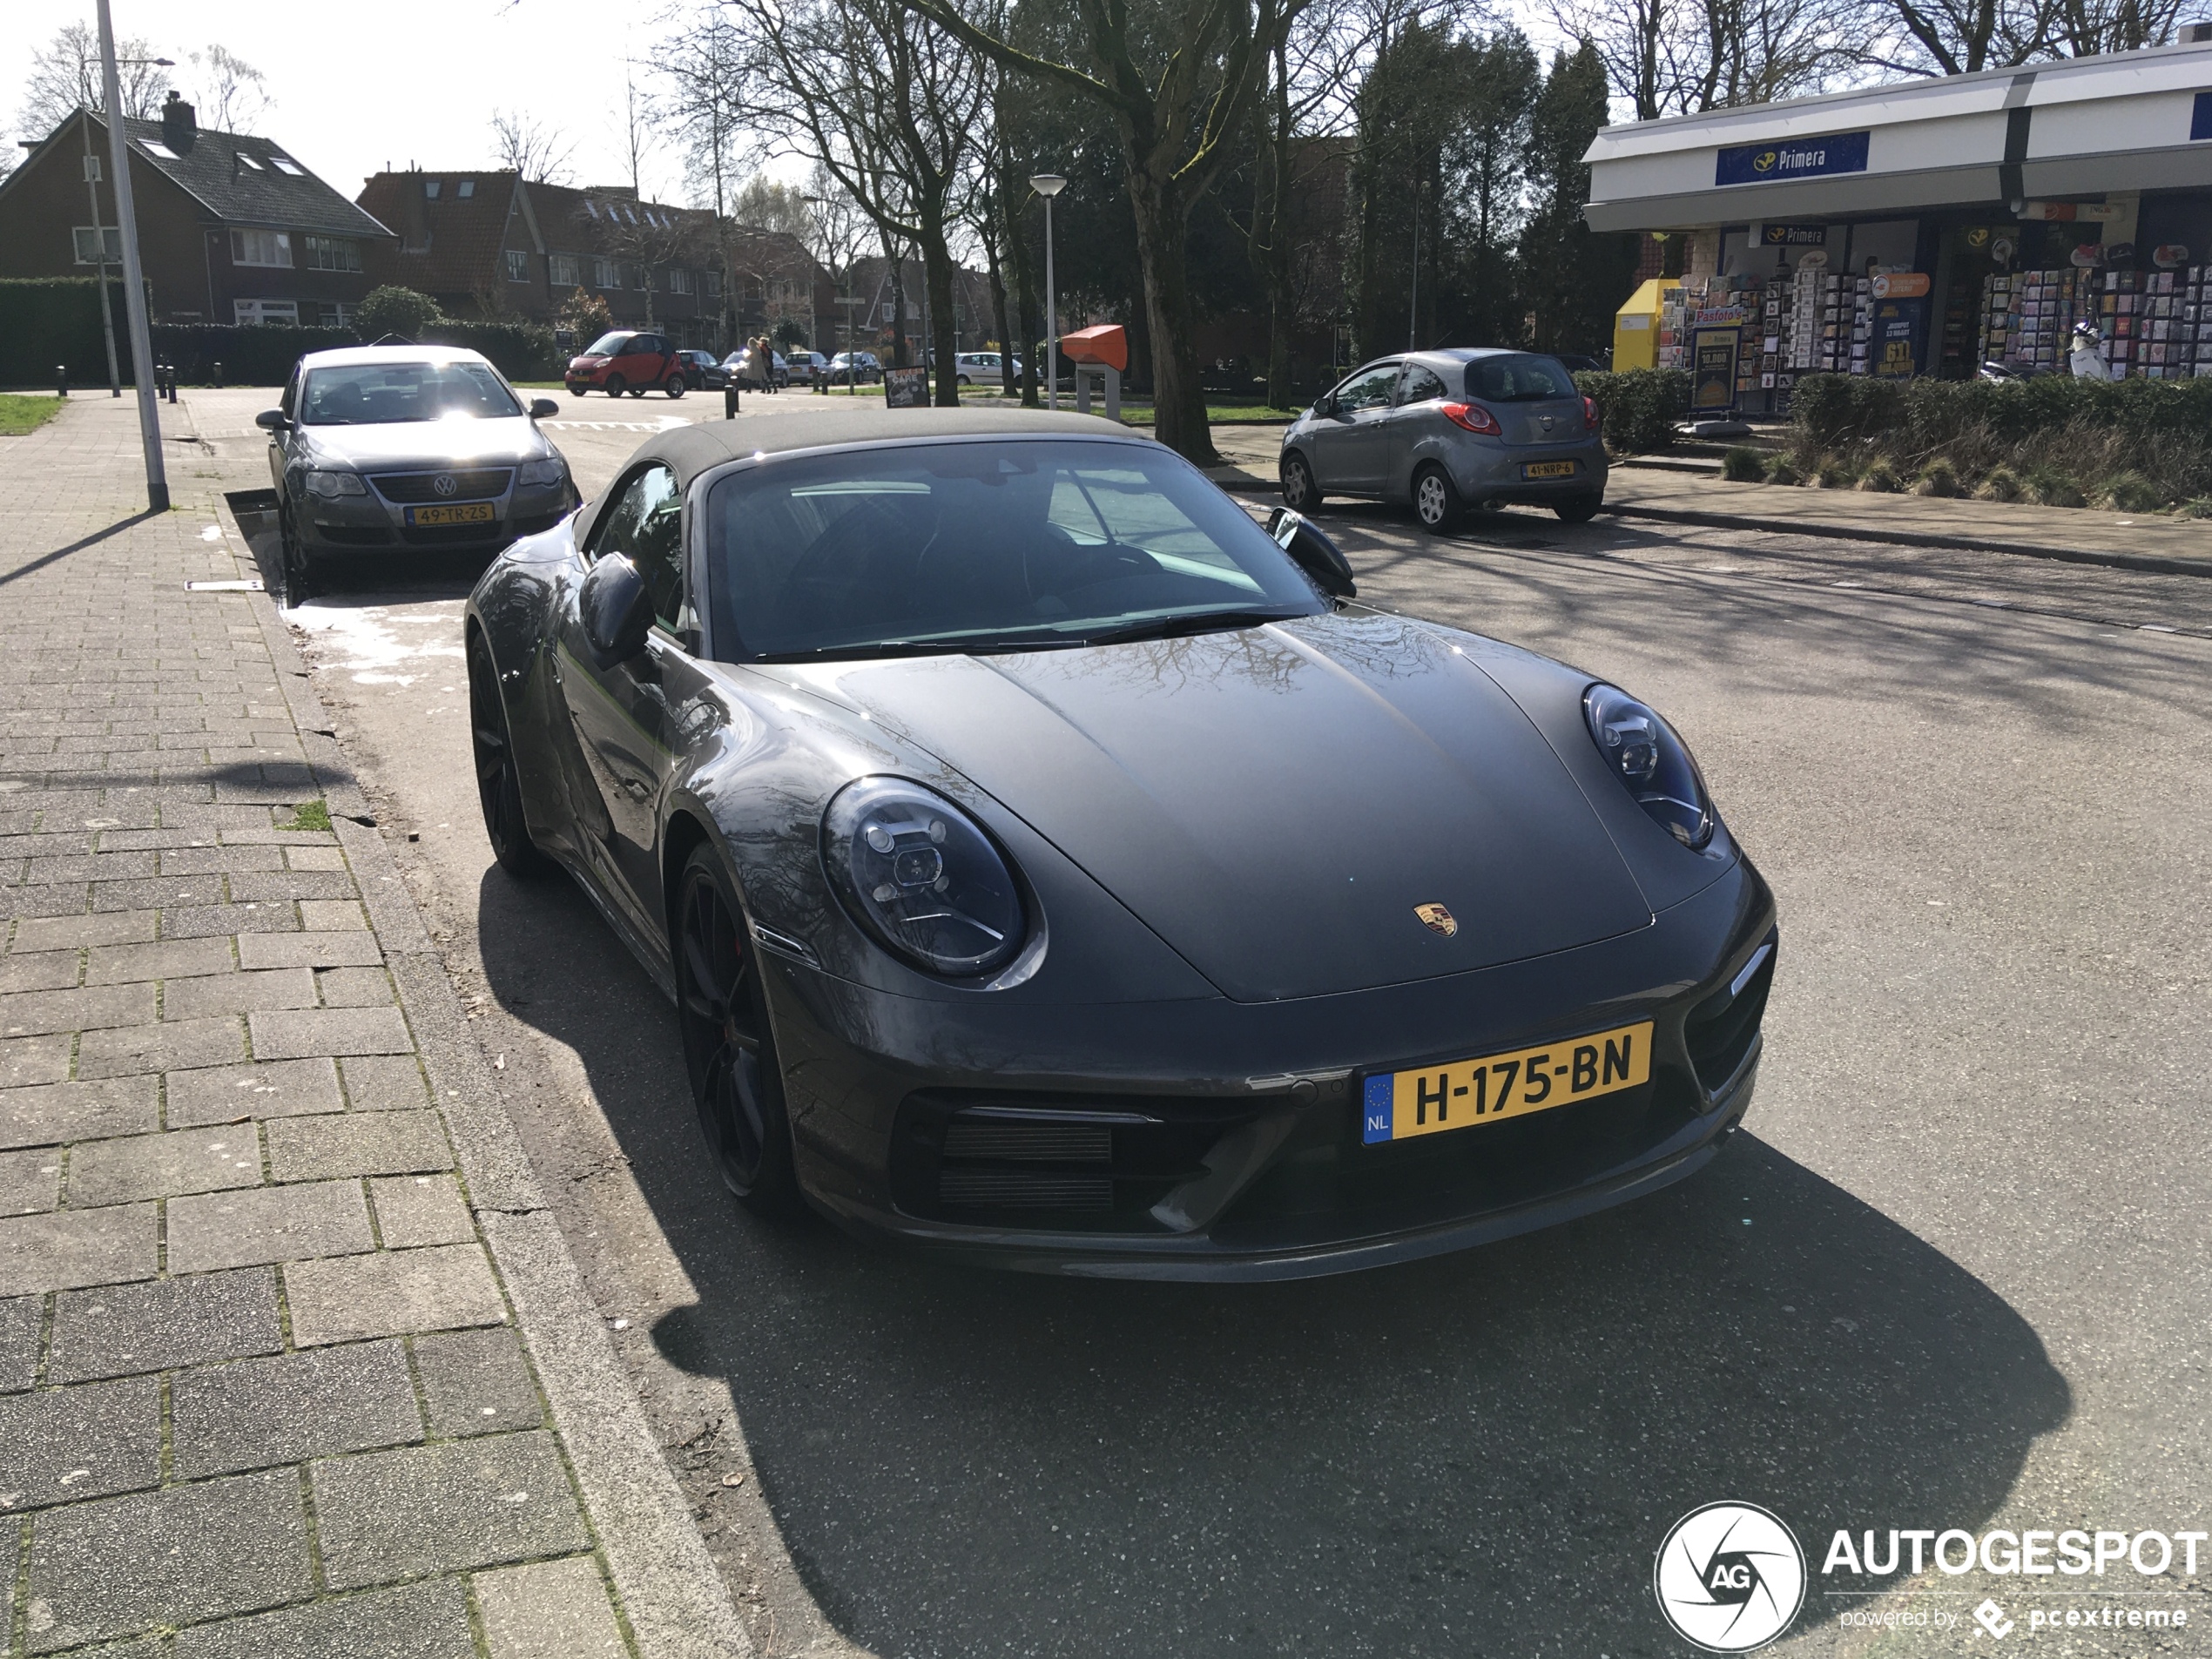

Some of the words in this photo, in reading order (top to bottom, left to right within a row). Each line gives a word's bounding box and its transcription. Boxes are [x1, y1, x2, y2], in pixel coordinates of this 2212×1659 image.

[1778, 150, 1825, 171] Primera
[1787, 227, 1822, 243] Primera
[1696, 308, 1742, 323] Pasfoto's
[1702, 353, 1727, 364] 10.000
[892, 374, 918, 383] CARE
[1530, 463, 1570, 475] 41-NRP-6
[421, 506, 488, 523] 49-TR-ZS
[1416, 1034, 1632, 1125] H-175-BN
[1368, 1115, 1389, 1131] NL
